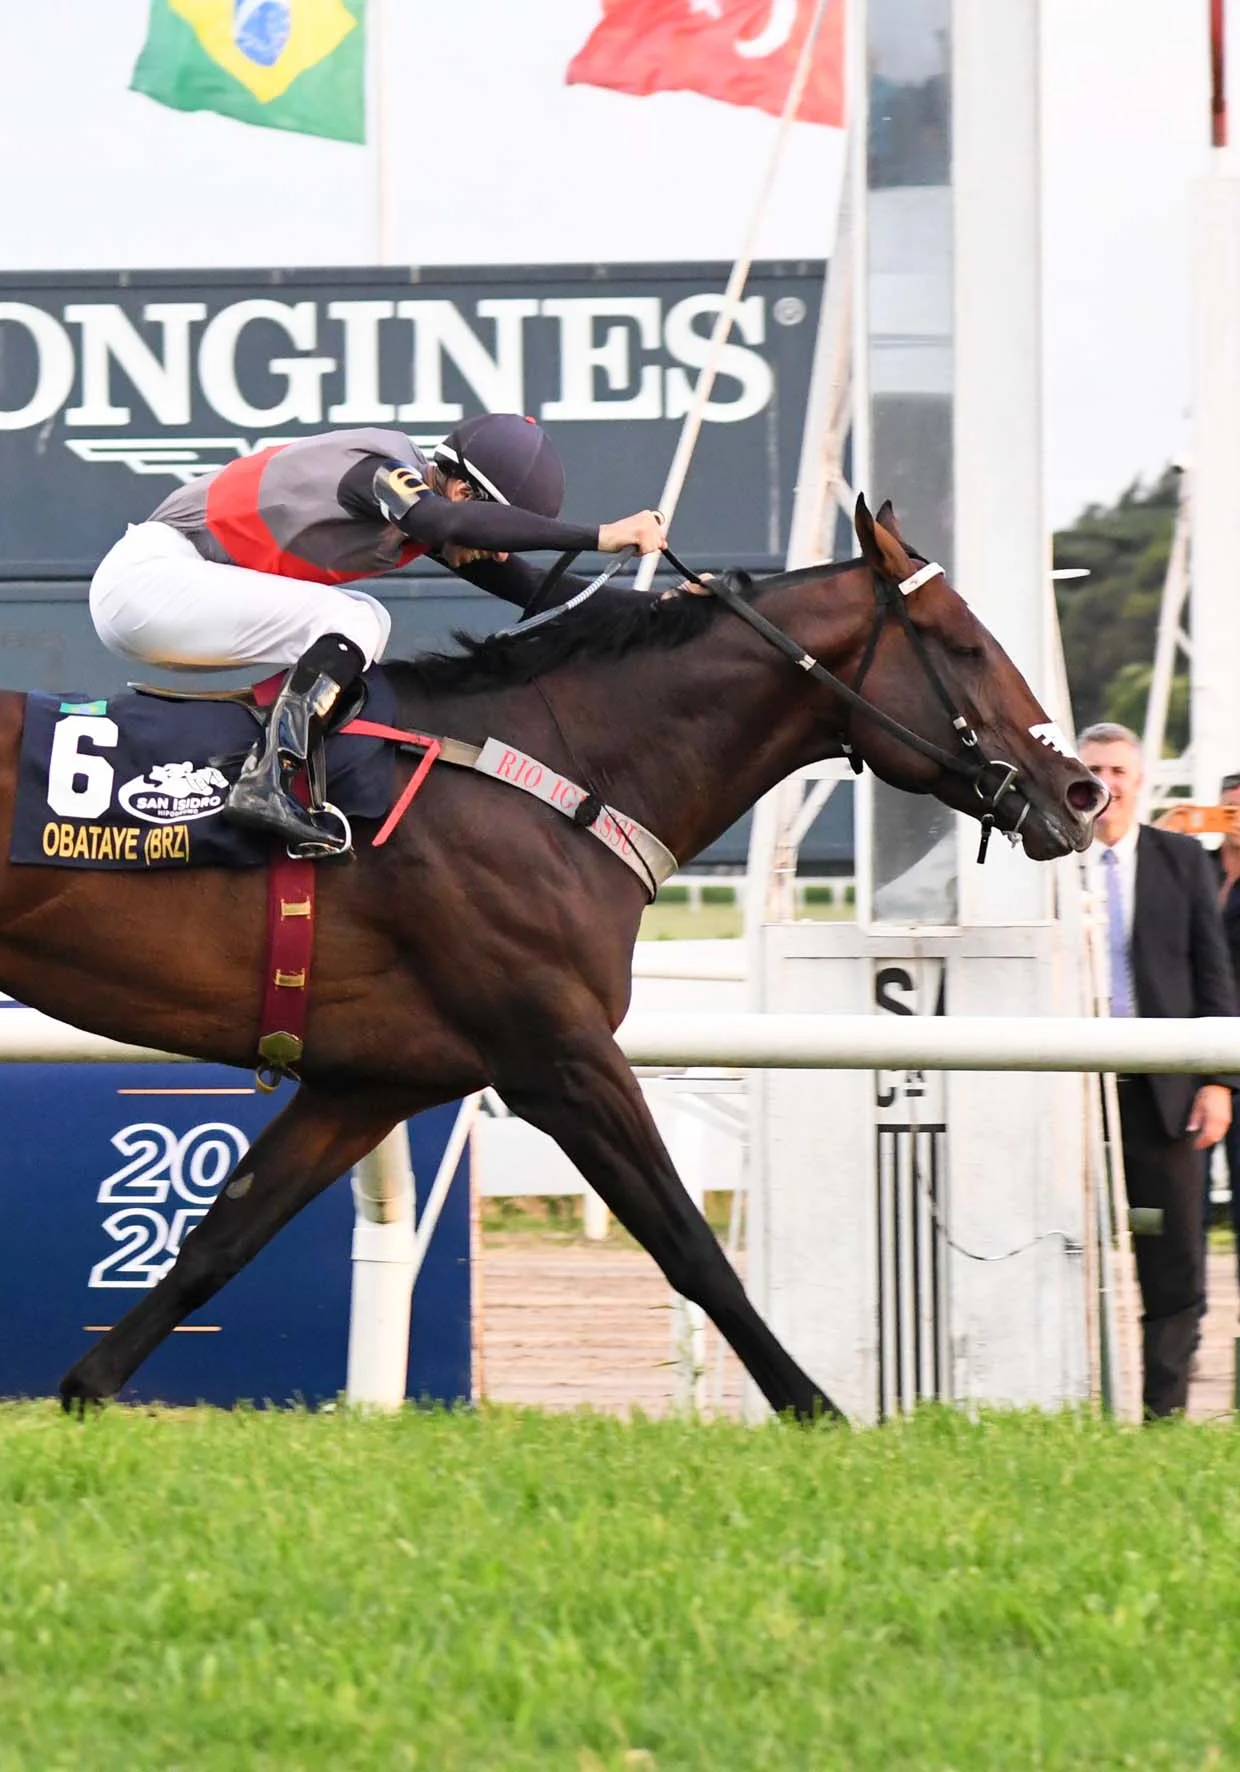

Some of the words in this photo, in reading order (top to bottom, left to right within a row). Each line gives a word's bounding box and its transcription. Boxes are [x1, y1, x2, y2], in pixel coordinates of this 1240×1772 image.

[47, 714, 118, 819] 6
[495, 749, 543, 789] RIO
[136, 797, 169, 810] SAN
[173, 796, 221, 811] ISIDRO
[42, 821, 140, 860] OBATAYE
[144, 824, 189, 865] (BRZ)
[96, 1122, 250, 1205] 20
